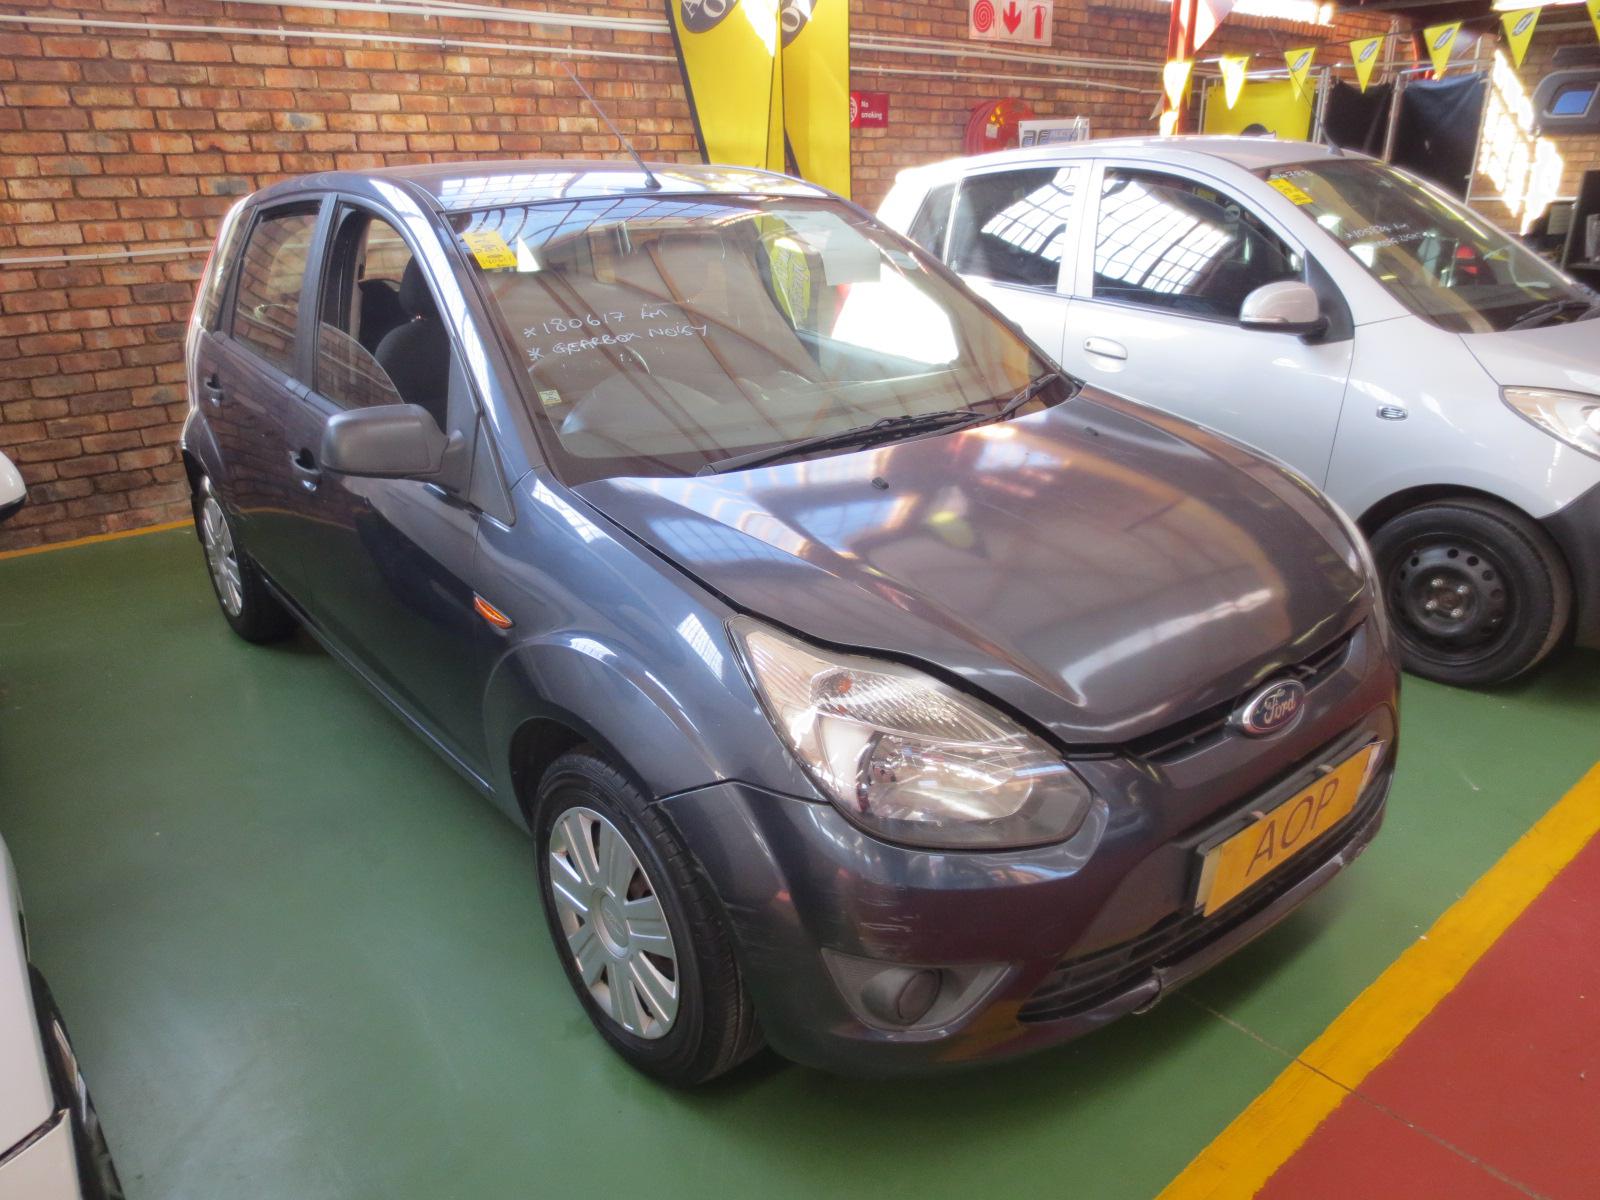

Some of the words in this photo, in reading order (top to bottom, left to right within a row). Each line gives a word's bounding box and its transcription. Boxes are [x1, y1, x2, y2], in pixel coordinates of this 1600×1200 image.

[861, 100, 869, 108] No
[861, 112, 882, 120] smoking
[1260, 688, 1296, 724] Ford
[1245, 778, 1340, 877] AOP
